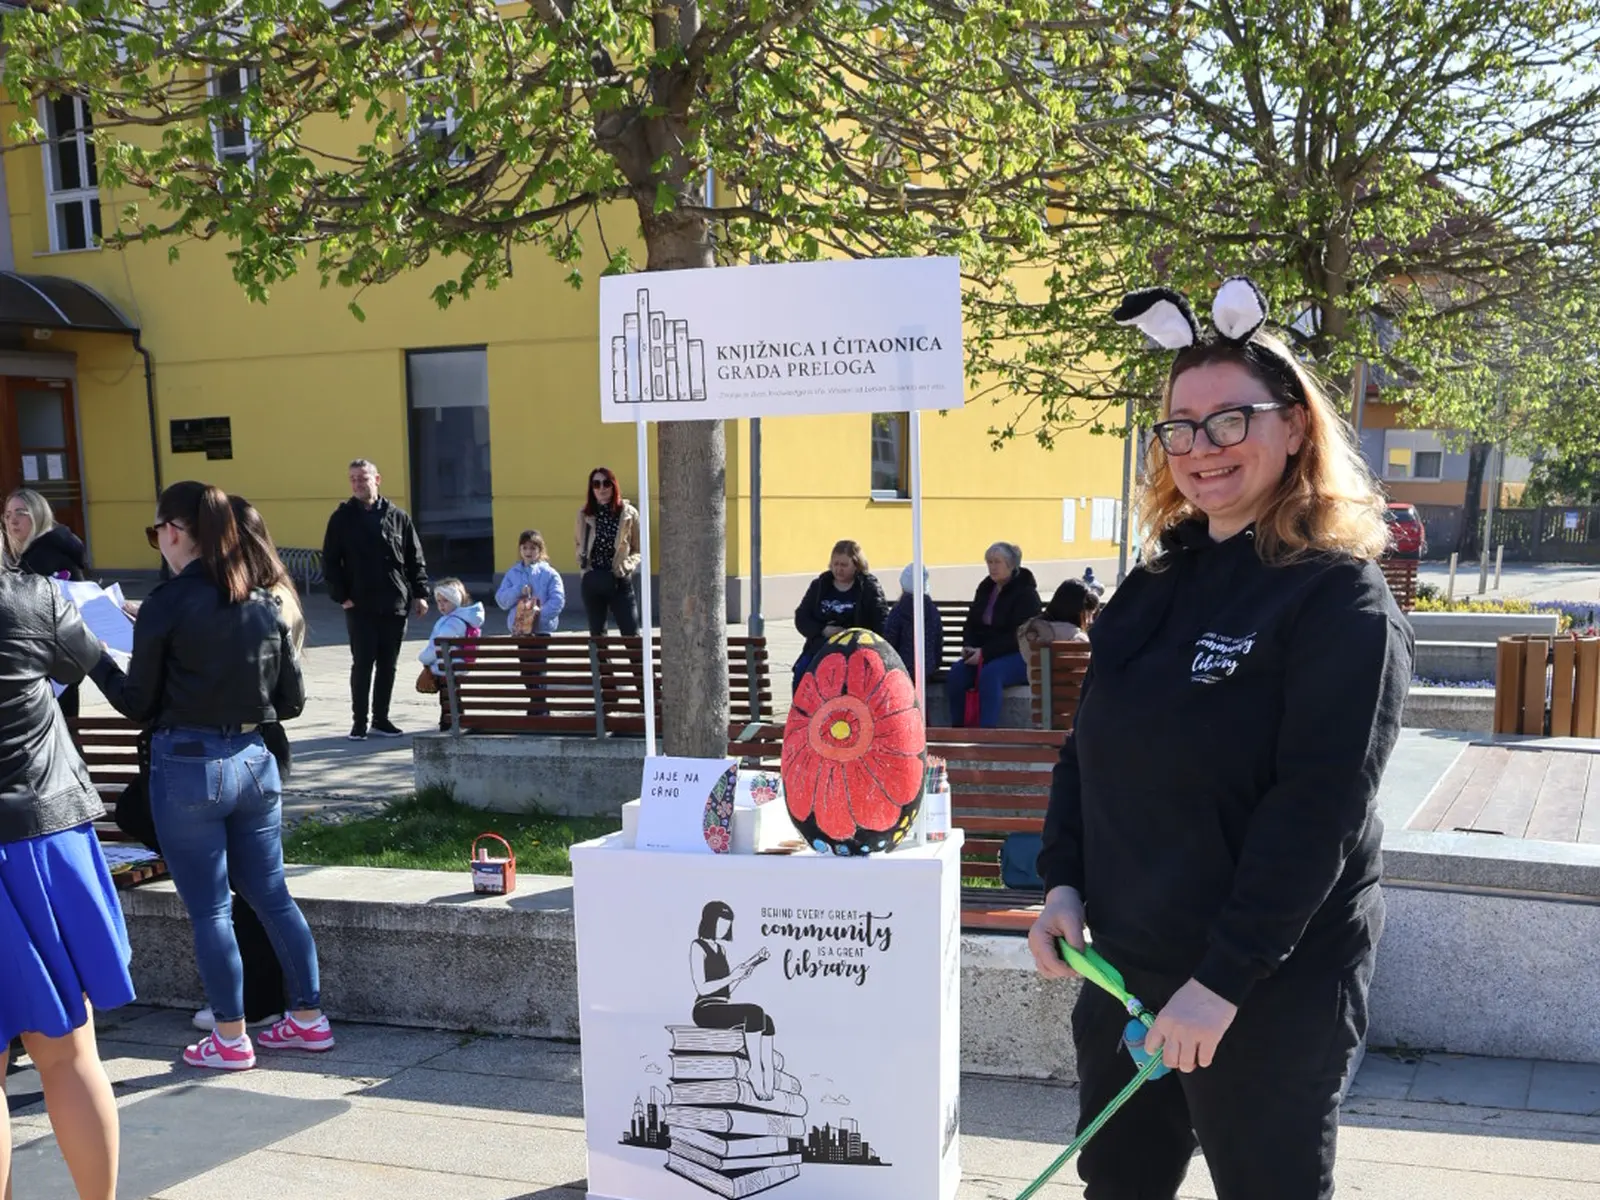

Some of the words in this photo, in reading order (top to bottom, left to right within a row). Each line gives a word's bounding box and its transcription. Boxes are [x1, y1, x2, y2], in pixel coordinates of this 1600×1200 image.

[716, 340, 815, 364] KNJIŽNICA
[821, 340, 827, 356] I
[833, 336, 943, 356] ČITAONICA
[717, 363, 782, 380] GRADA
[787, 359, 876, 378] PRELOGA
[652, 771, 679, 782] JAJE
[684, 773, 700, 783] NA
[760, 907, 793, 919] BEHIND
[796, 908, 825, 920] EVERY
[828, 910, 858, 921] GREAT
[760, 911, 893, 952] community
[817, 946, 826, 957] IS
[827, 947, 834, 957] A
[836, 947, 865, 958] GREAT
[783, 948, 870, 987] library
